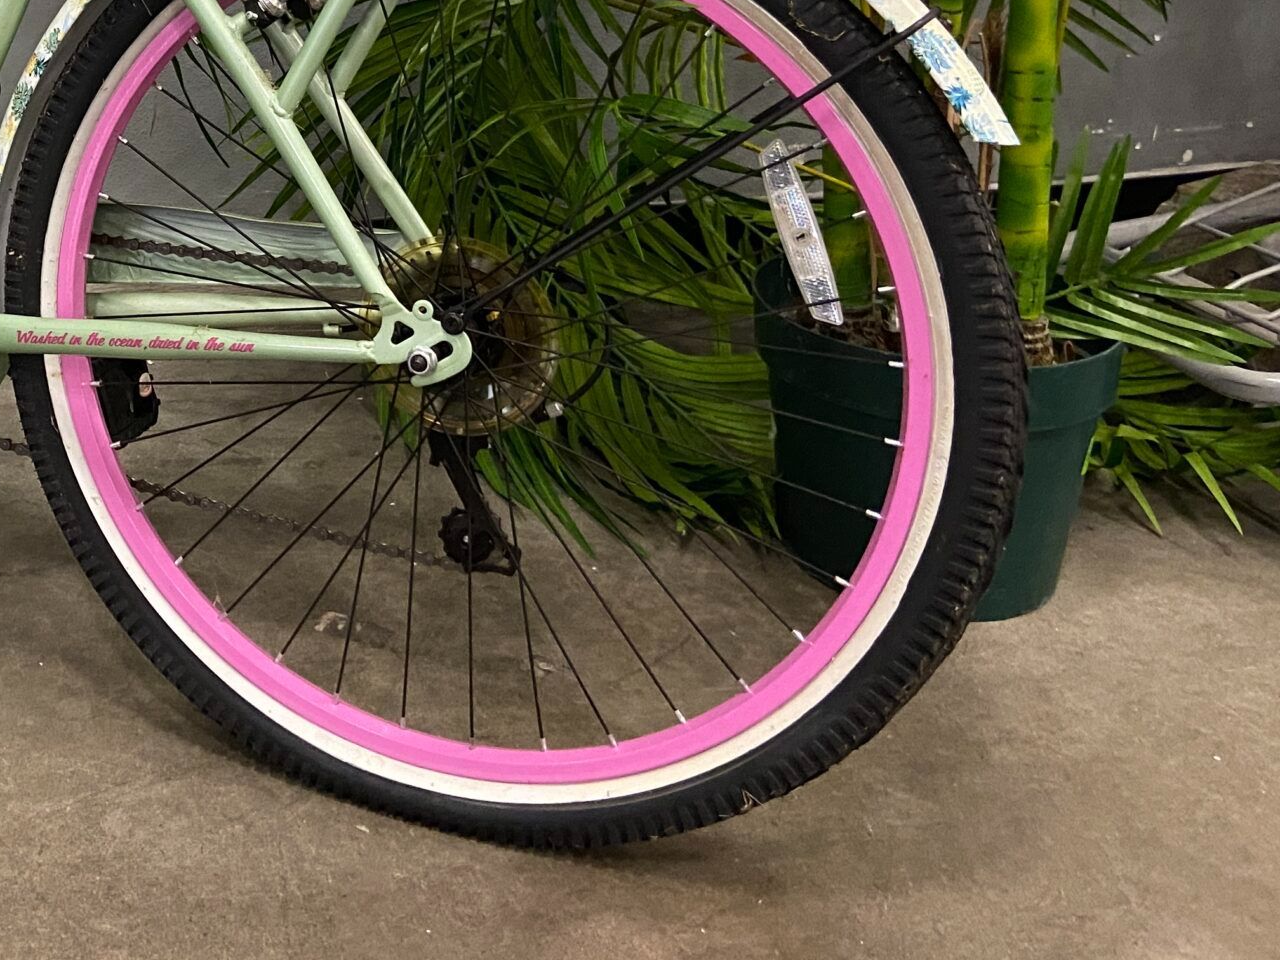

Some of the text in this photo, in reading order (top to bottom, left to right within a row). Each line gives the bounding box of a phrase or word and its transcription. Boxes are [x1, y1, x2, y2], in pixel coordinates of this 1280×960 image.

[16, 329, 68, 346] Washed
[69, 335, 82, 346] in
[86, 331, 105, 347] the
[185, 339, 200, 350] in
[203, 336, 225, 352] the
[228, 342, 255, 353] sun
